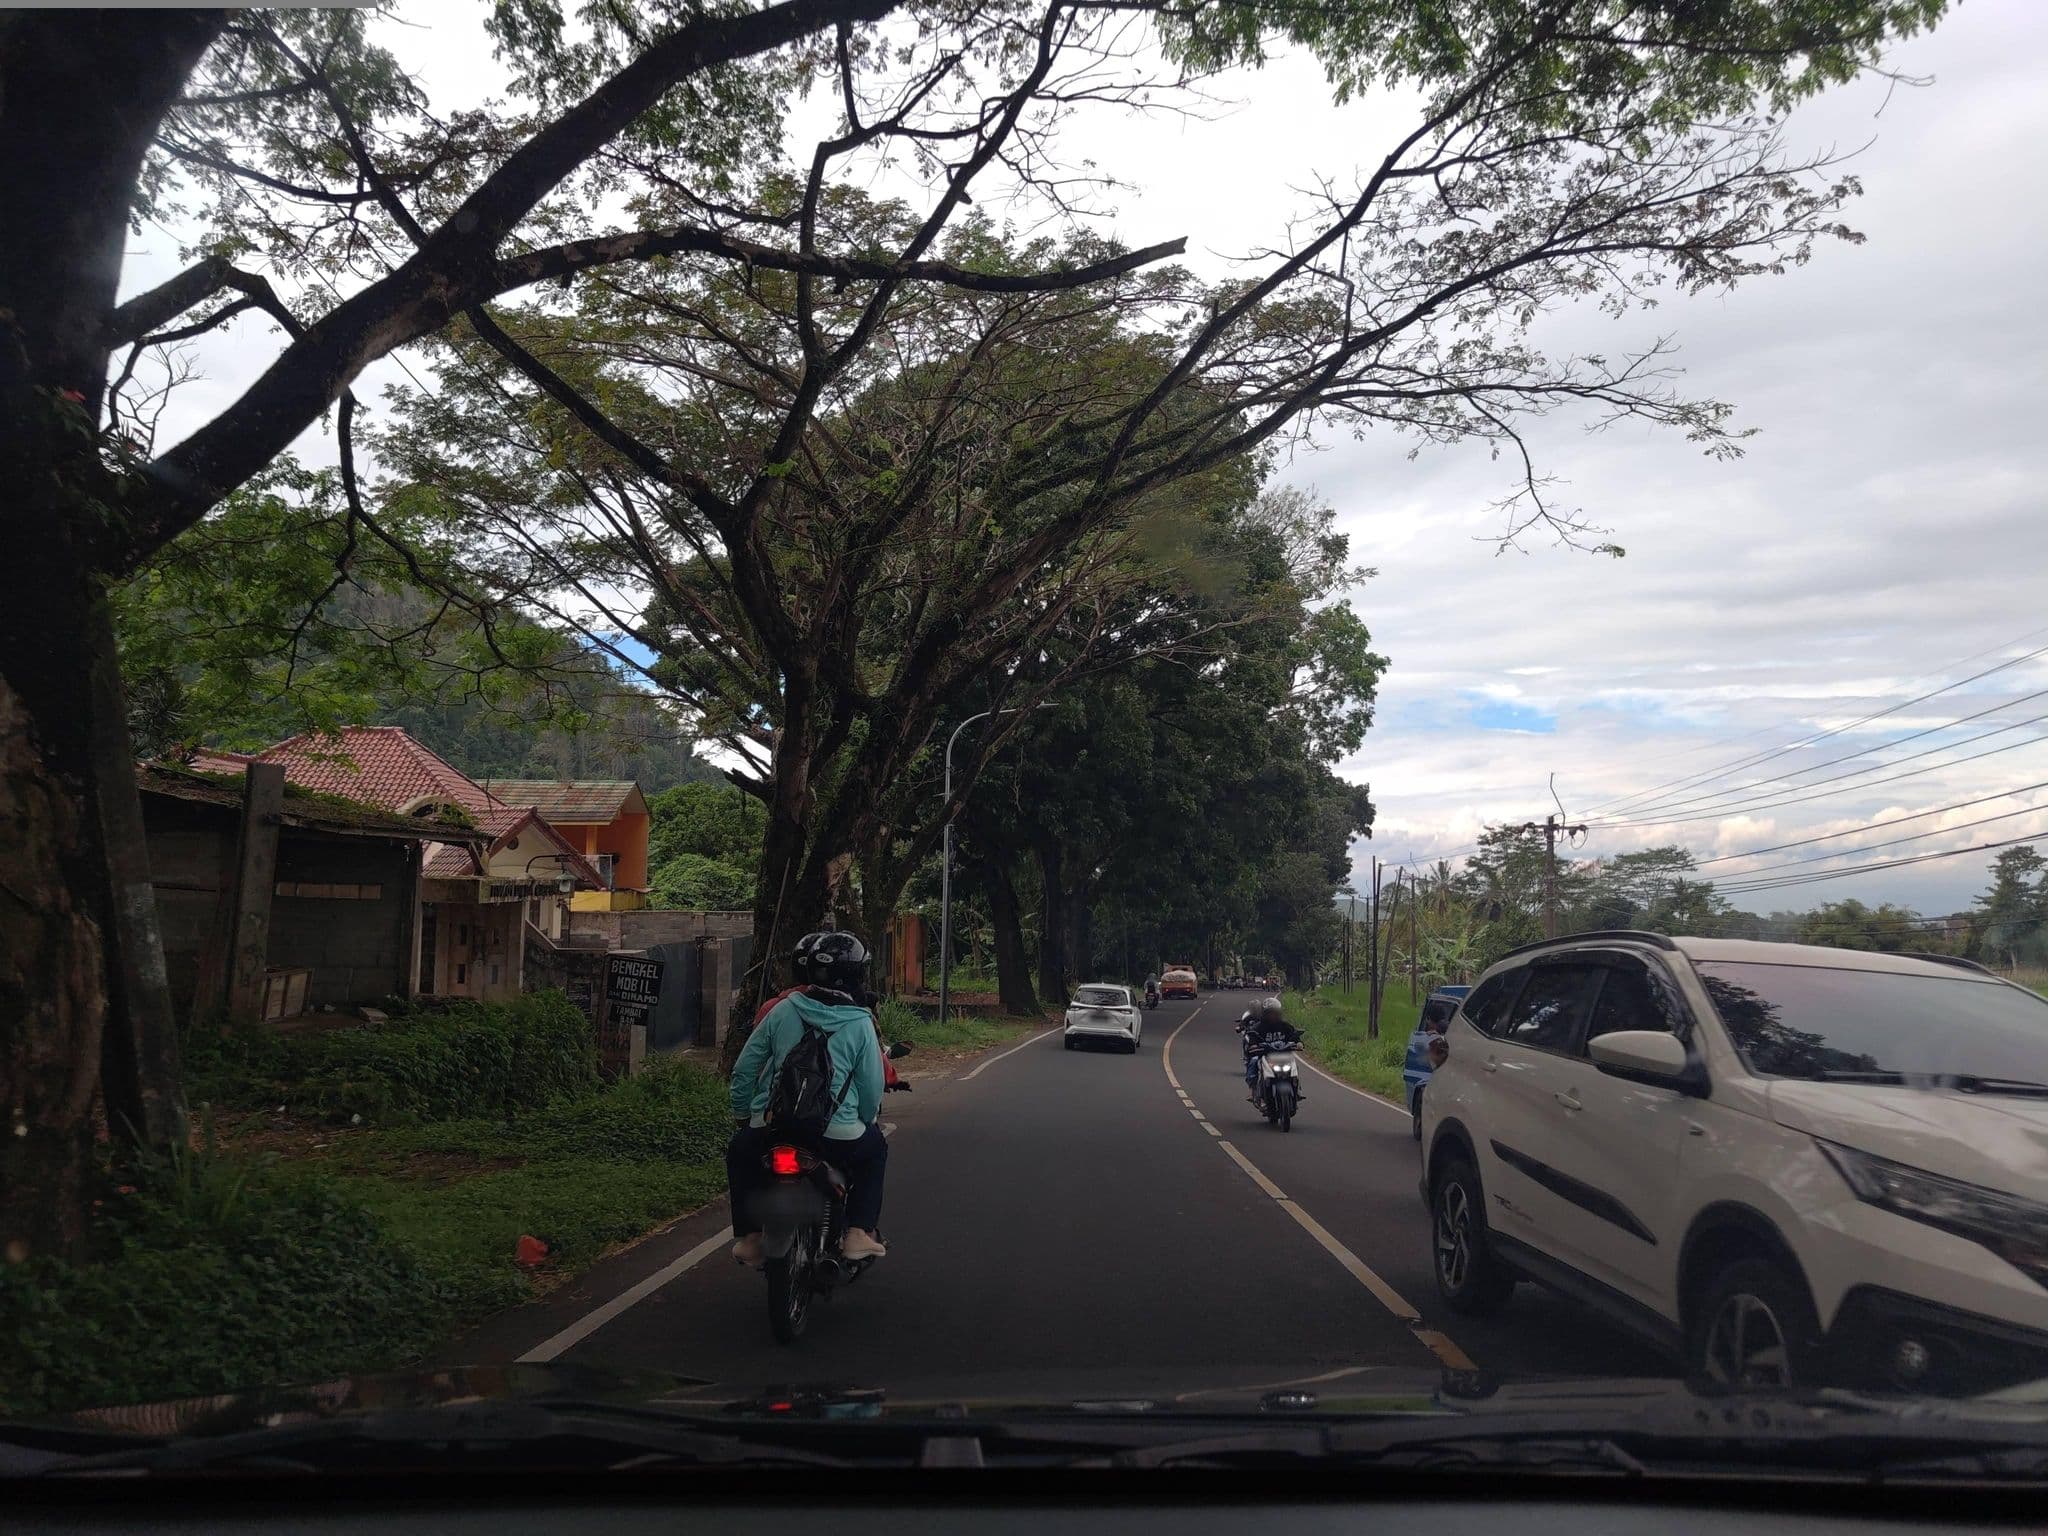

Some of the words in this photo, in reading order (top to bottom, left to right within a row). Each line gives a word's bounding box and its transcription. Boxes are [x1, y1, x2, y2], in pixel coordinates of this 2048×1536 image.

[611, 960, 658, 979] BENGKEL
[616, 976, 650, 993] MOBIL
[621, 991, 658, 1004] DINAMO
[616, 1005, 642, 1018] TAMBAL
